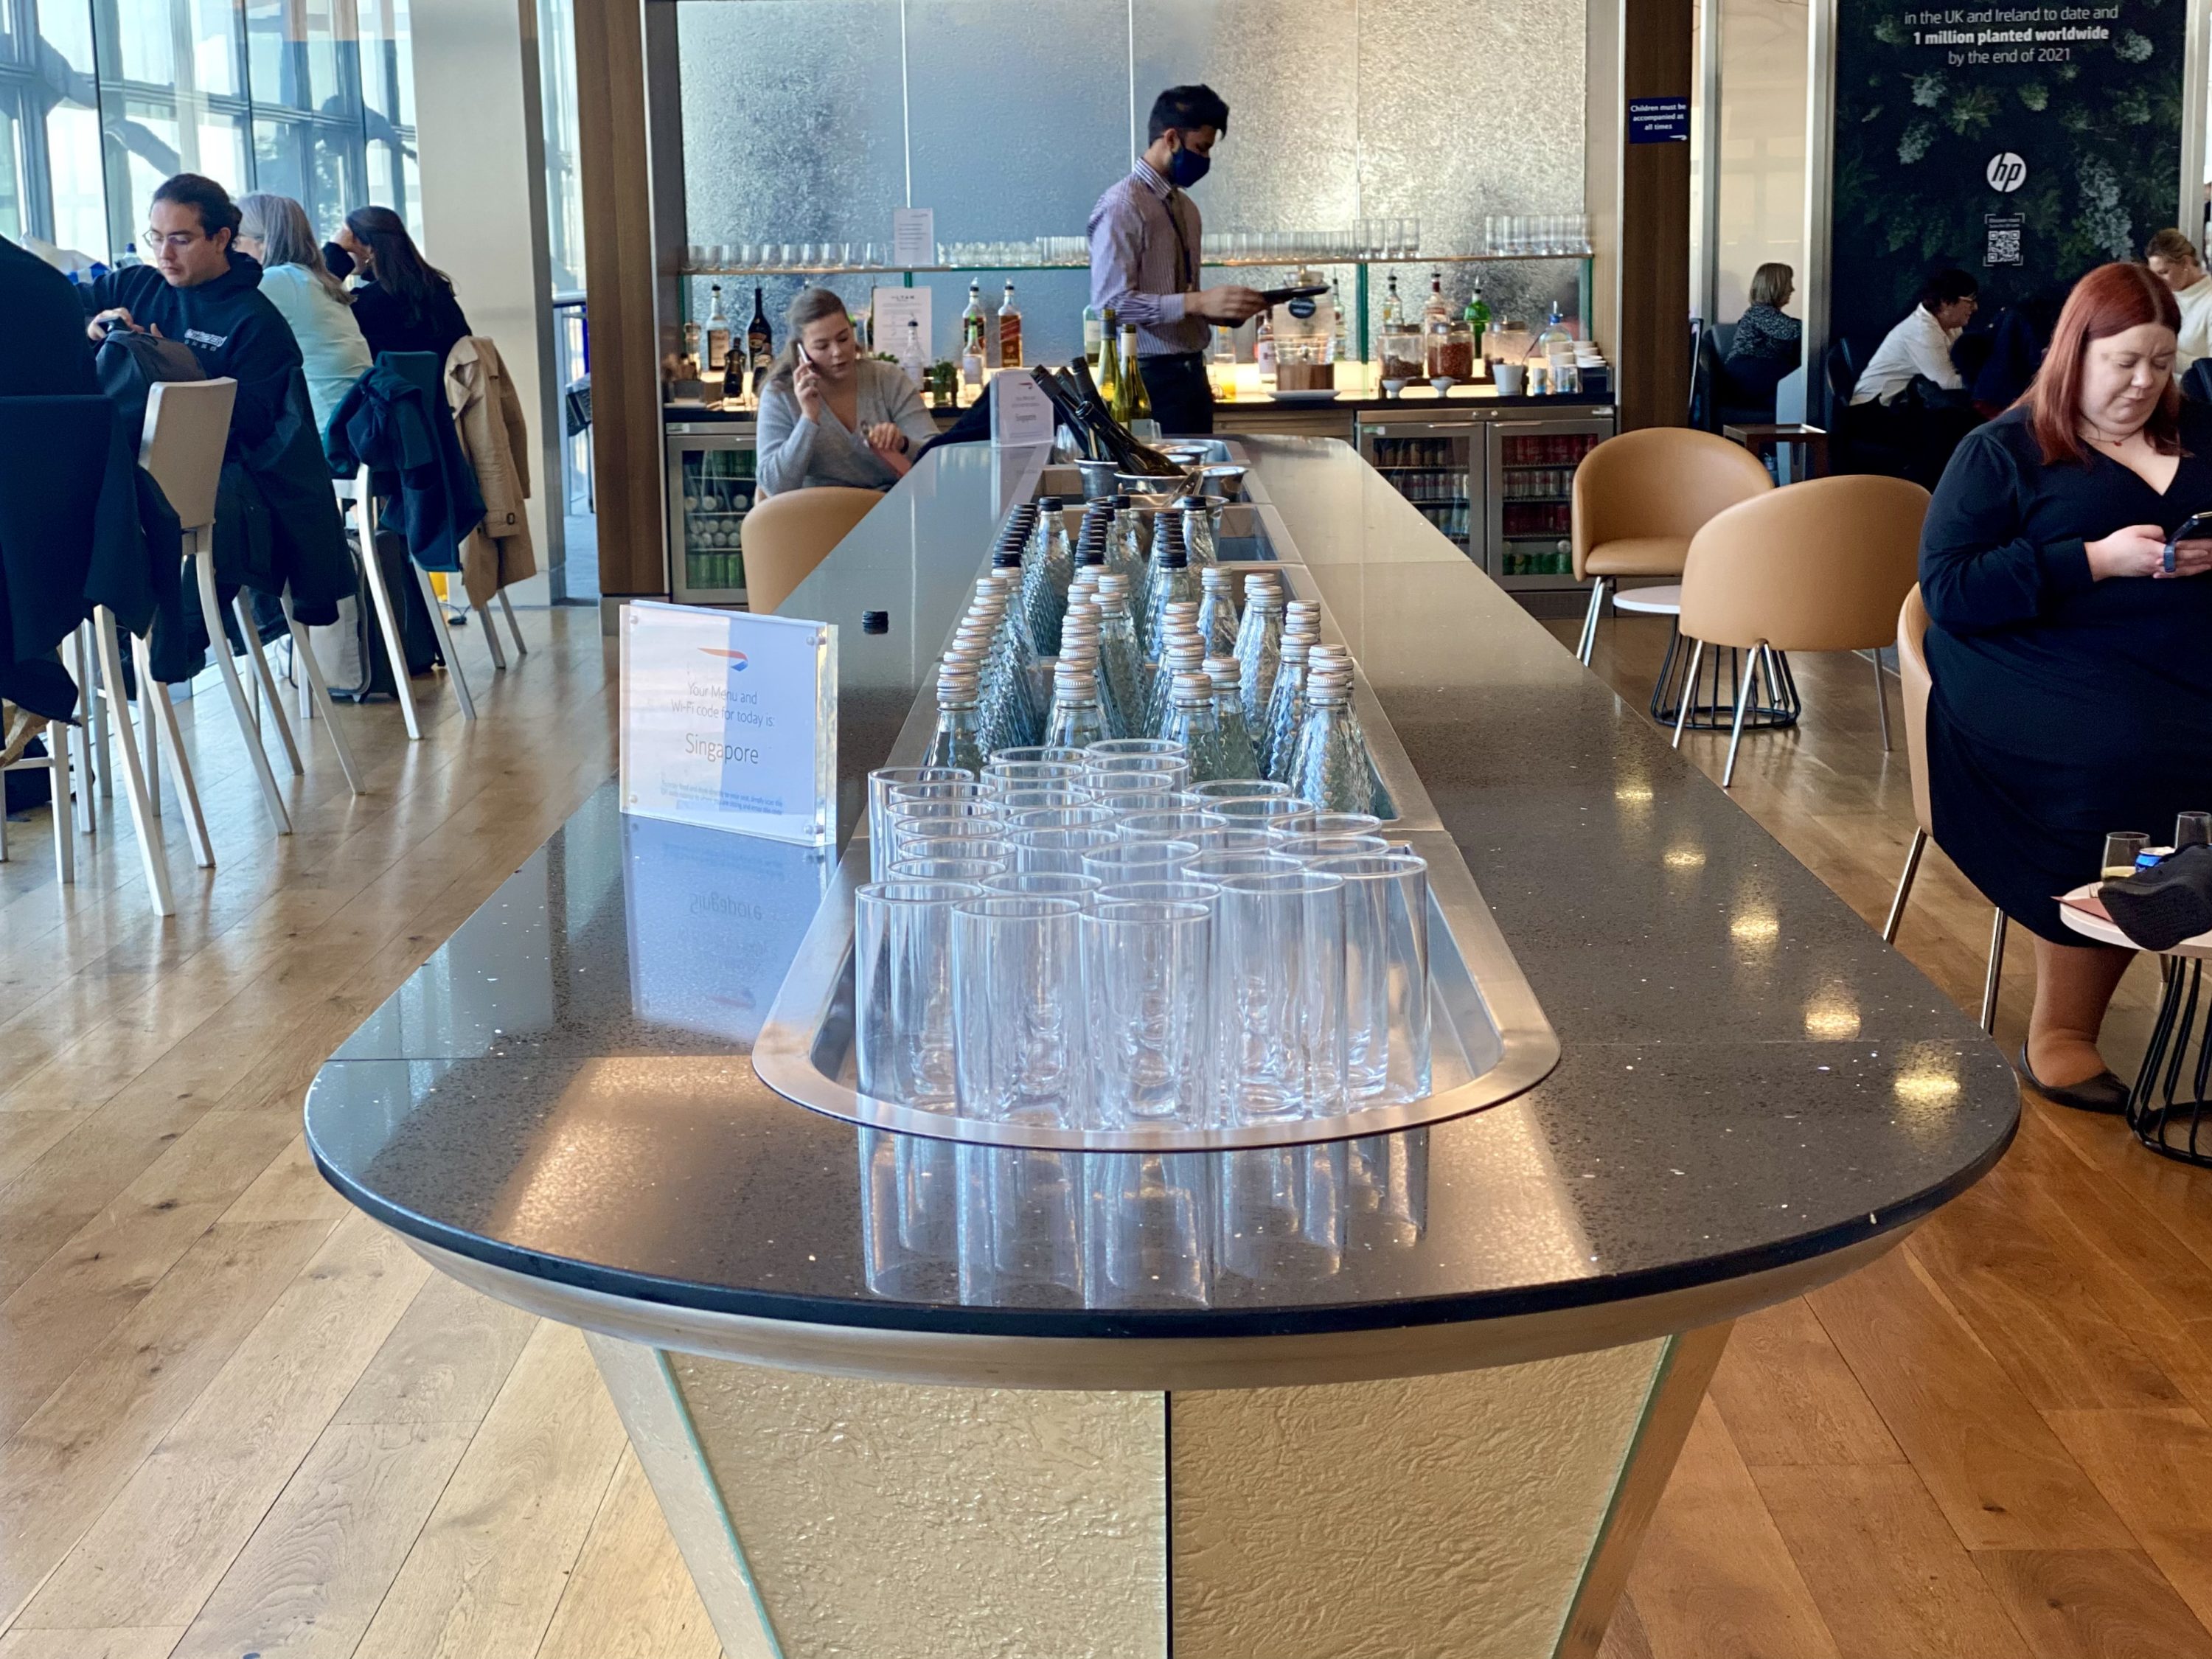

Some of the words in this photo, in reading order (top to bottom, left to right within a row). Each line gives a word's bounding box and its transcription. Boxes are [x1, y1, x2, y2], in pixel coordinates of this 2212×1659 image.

[1905, 11, 1917, 24] in
[1919, 10, 1942, 24] the
[1944, 10, 1964, 24] UK
[1966, 9, 1992, 23] and
[1995, 7, 2040, 22] Ireland
[2044, 8, 2057, 21] to
[2060, 6, 2090, 20] date
[2093, 4, 2118, 19] and
[1913, 32, 1921, 45] 1
[1924, 29, 1975, 44] million
[1977, 27, 2033, 46] planted
[2035, 26, 2109, 41] worldwide
[1948, 50, 1964, 67] by
[1968, 49, 1989, 63] the
[1992, 49, 2018, 63] end
[2020, 48, 2035, 62] of
[2037, 47, 2070, 62] 2021
[1989, 152, 2024, 192] hp
[687, 681, 709, 697] Your
[711, 685, 738, 702] Menu
[740, 692, 757, 705] and
[671, 698, 695, 714] Wi-Fi
[696, 705, 720, 719] code
[722, 706, 735, 720] for
[737, 711, 764, 728] today
[685, 732, 759, 765] Singapore
